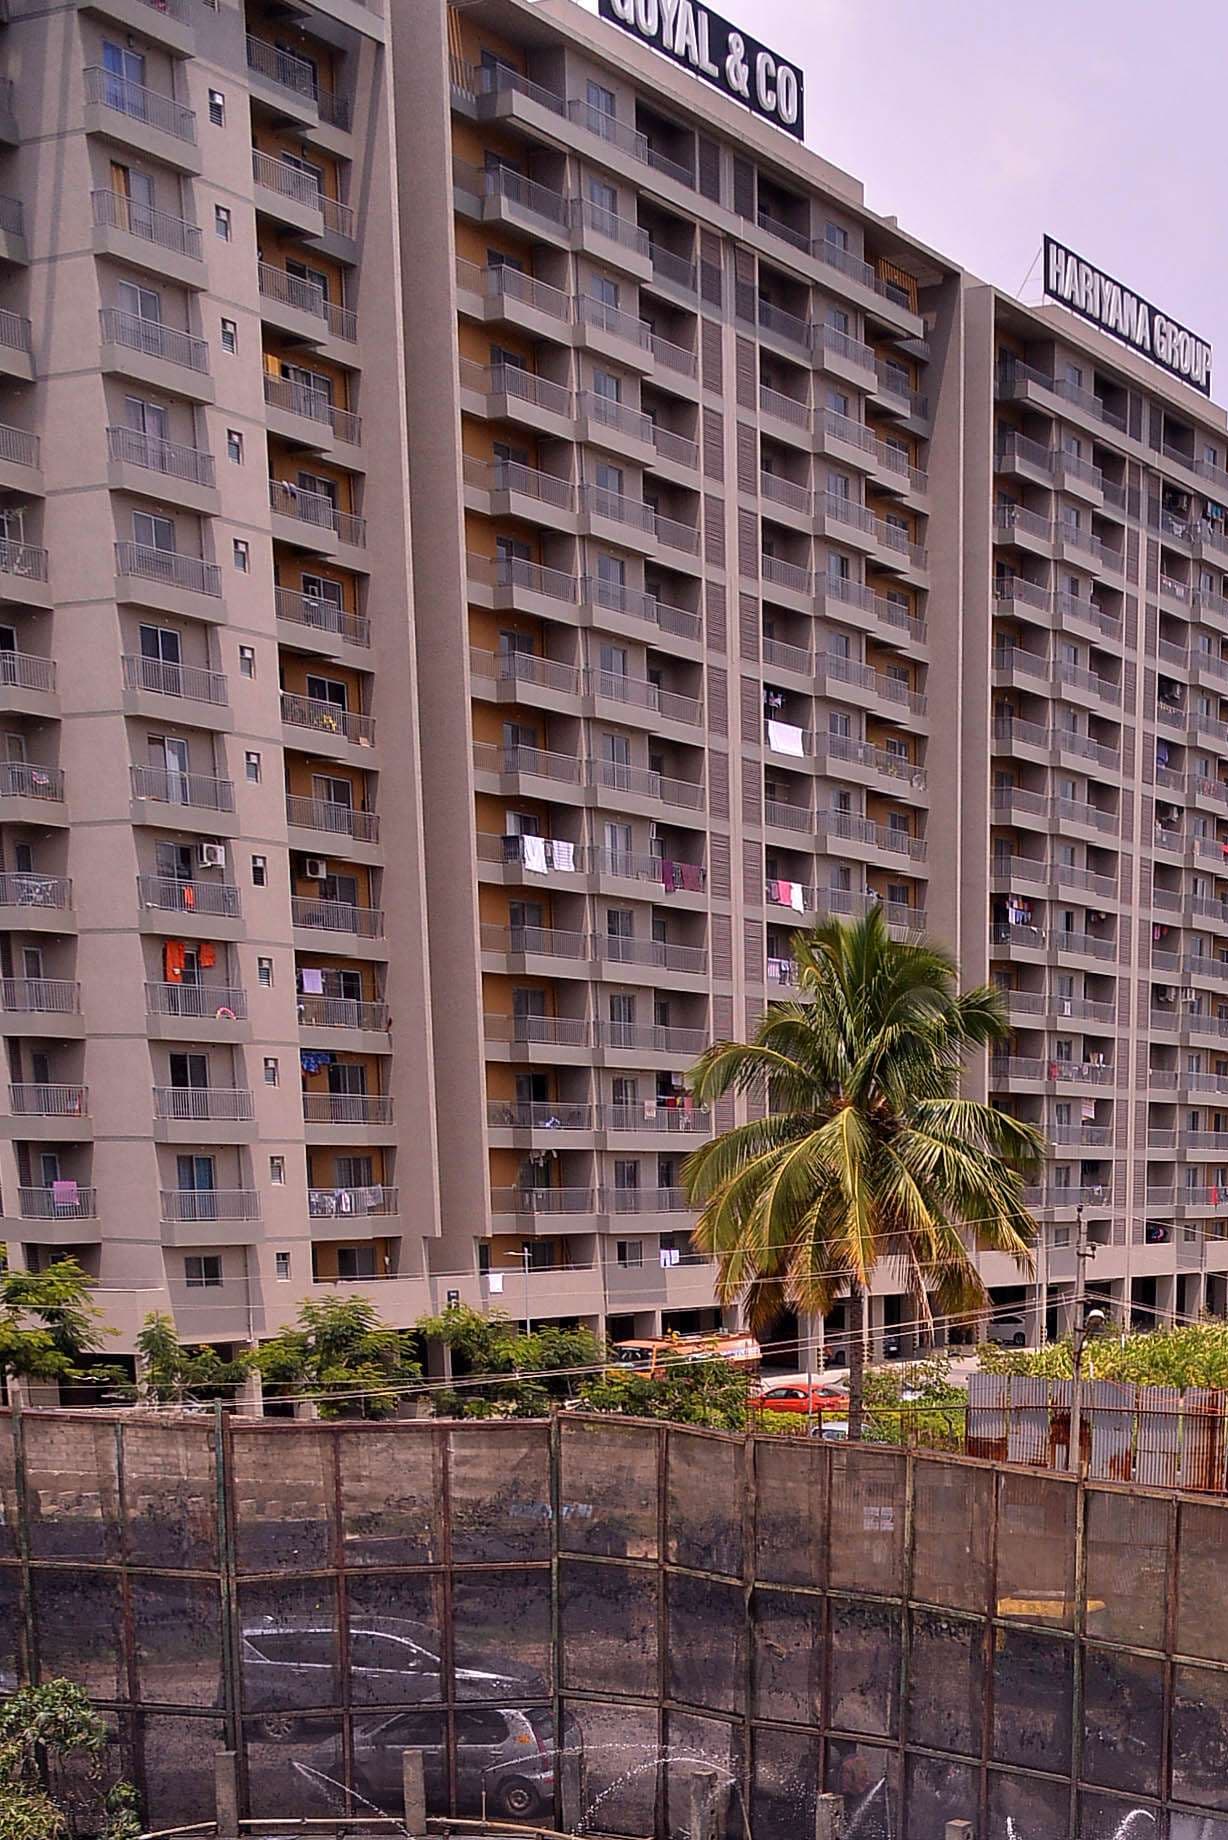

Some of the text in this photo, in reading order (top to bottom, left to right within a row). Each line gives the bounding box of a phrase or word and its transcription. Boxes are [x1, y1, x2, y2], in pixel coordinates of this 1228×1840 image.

[725, 32, 750, 98] &
[756, 52, 798, 125] CO
[1049, 243, 1212, 387] HARIYANA GROUP
